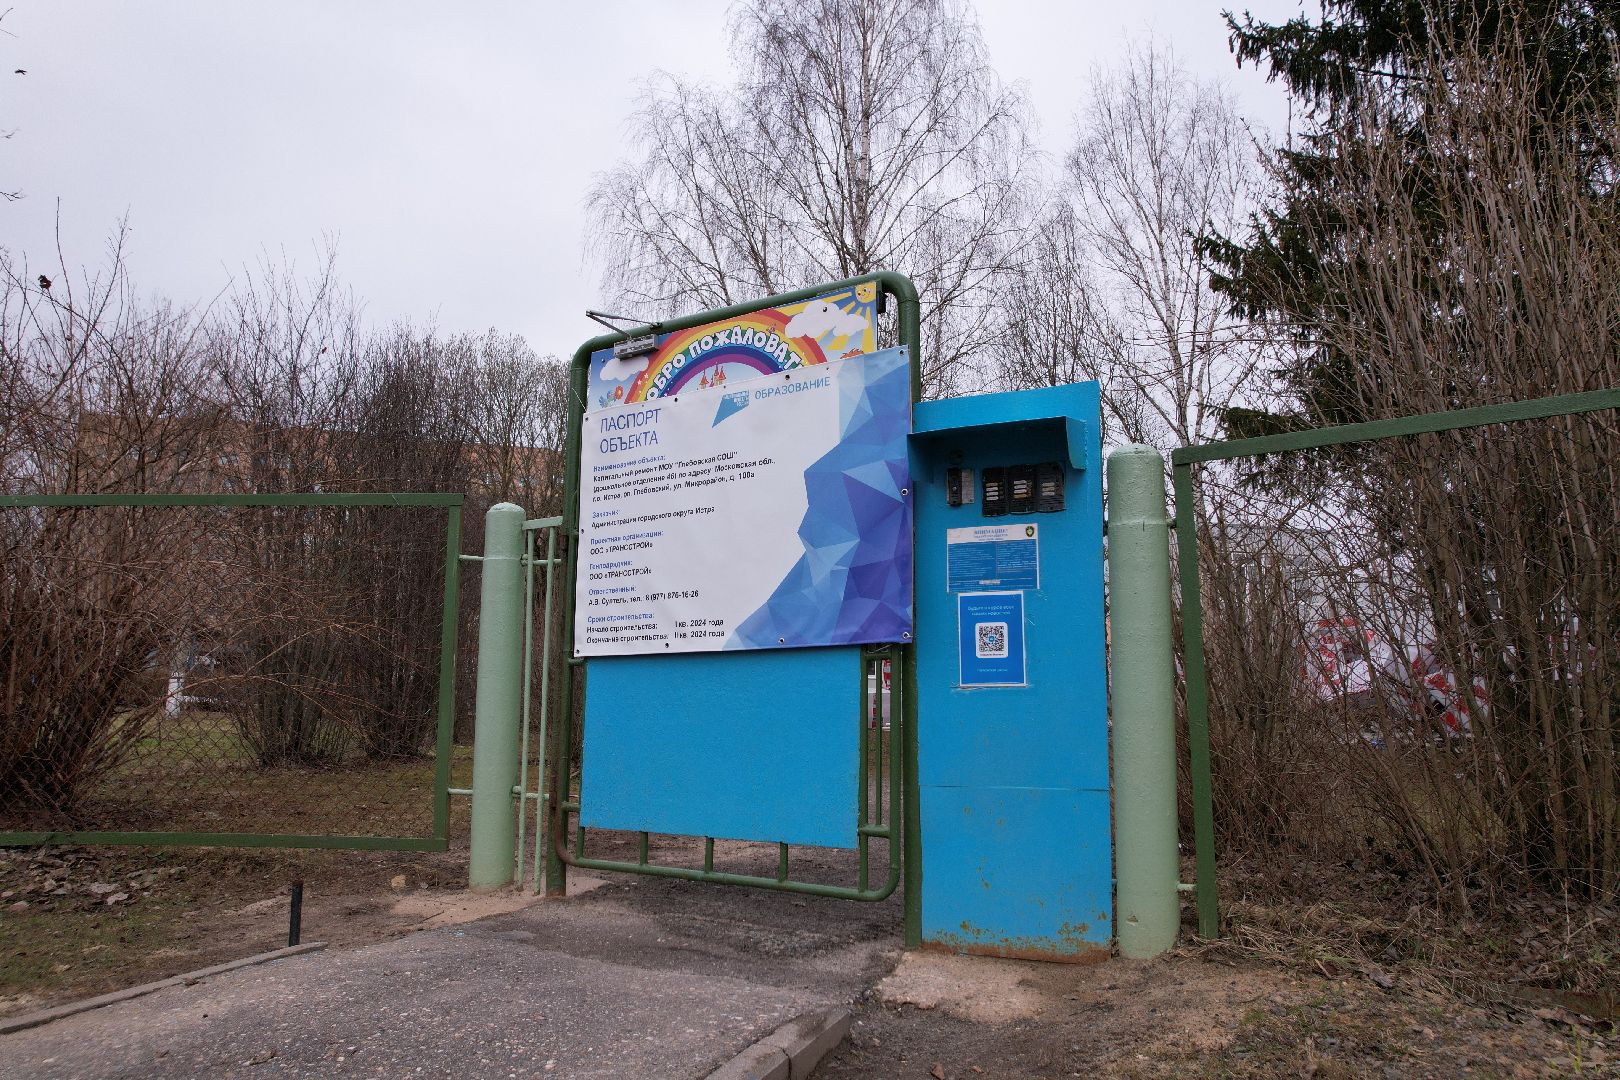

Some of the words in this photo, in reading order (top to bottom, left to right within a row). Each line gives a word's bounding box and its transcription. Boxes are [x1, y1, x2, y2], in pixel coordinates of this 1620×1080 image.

[646, 353, 687, 400] ОБРО
[688, 325, 804, 370] ПОЖАЛОВАТ
[755, 376, 831, 400] ОБРАЗОВАНИЕ
[600, 408, 661, 433] ПАСПОРТ
[600, 431, 658, 453] ОБЪЕКТА
[593, 460, 636, 472] Наименование
[638, 455, 666, 464] объекта:
[593, 470, 634, 482] Капитальный
[635, 467, 658, 476] ремонт
[659, 462, 673, 471] МОУ
[632, 476, 666, 486] отделение
[714, 460, 757, 472] Московская
[633, 484, 672, 496] Глебовский,
[684, 476, 728, 488] Микрорайон,
[739, 471, 755, 479] 100а
[591, 517, 637, 529] Администрация
[637, 511, 672, 522] городского
[672, 508, 694, 518] округа
[695, 506, 715, 514] Истра
[590, 535, 621, 545] Проектная
[590, 547, 604, 555] ООО
[589, 560, 633, 570] Генподрядчик:
[589, 572, 603, 580] ООО
[588, 586, 637, 595] Ответственный:
[650, 592, 666, 602] (977)
[586, 625, 609, 633] Начало
[609, 623, 658, 633] строительства:
[690, 619, 706, 627] 2024
[708, 619, 724, 627] года
[587, 615, 606, 624] Сроки
[606, 613, 655, 622] строительства:
[586, 635, 619, 644] Окончание
[620, 633, 669, 643] строительства:
[690, 630, 707, 638] 2024
[708, 630, 725, 638] года
